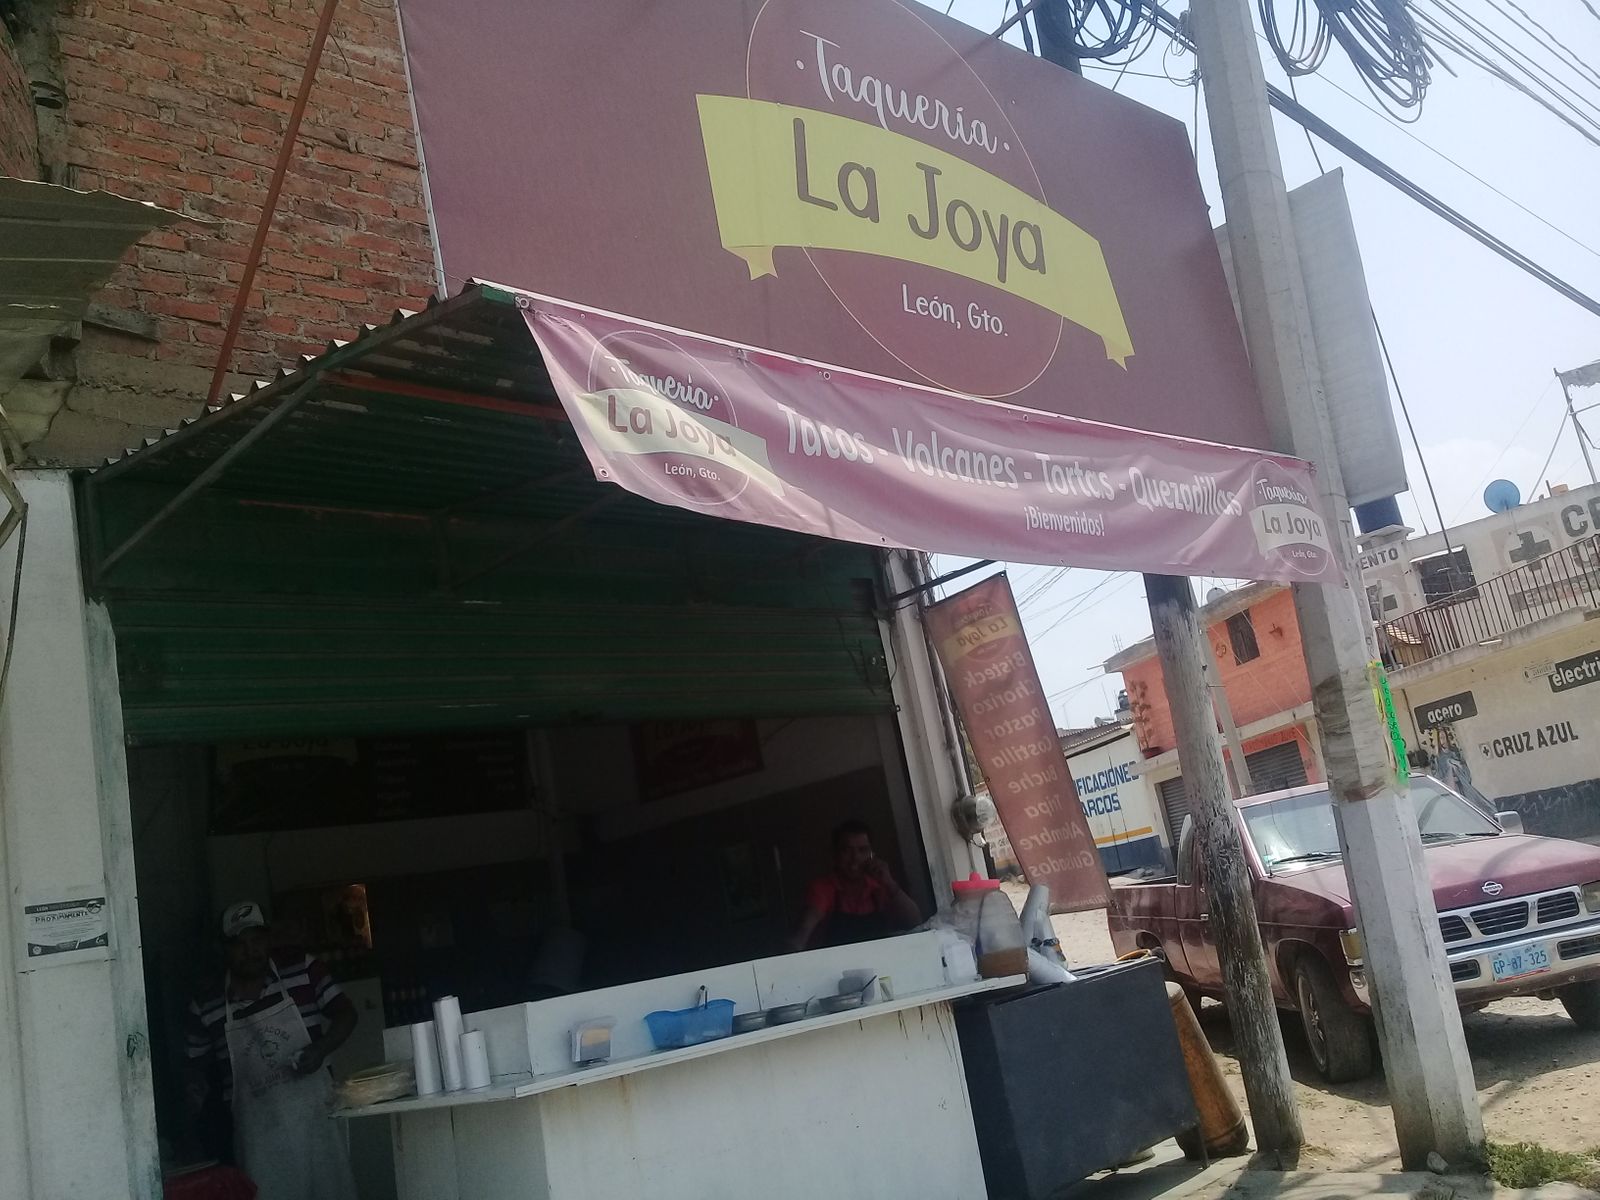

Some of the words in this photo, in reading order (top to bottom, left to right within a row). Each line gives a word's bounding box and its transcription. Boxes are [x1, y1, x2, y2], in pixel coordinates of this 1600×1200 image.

[793, 117, 880, 223] La
[907, 162, 1047, 283] Joya
[902, 283, 962, 331] León,
[967, 302, 1009, 337] Gto.
[606, 394, 653, 435] La
[665, 407, 737, 457] Joya
[665, 461, 697, 479] León,
[699, 466, 722, 482] Gto.
[776, 402, 875, 465] Tacos
[891, 427, 1020, 491] Volcanes
[1035, 452, 1116, 501] Tortas
[1128, 466, 1243, 517] Quezadillas
[1023, 505, 1107, 539] ¡Bienvenidos!
[1261, 510, 1283, 535] La
[1287, 511, 1322, 541] Joya
[1427, 702, 1462, 724] acero
[1493, 731, 1535, 758] CRUZ
[1536, 721, 1579, 749] AZUL
[1492, 950, 1547, 975] GP-87-325
